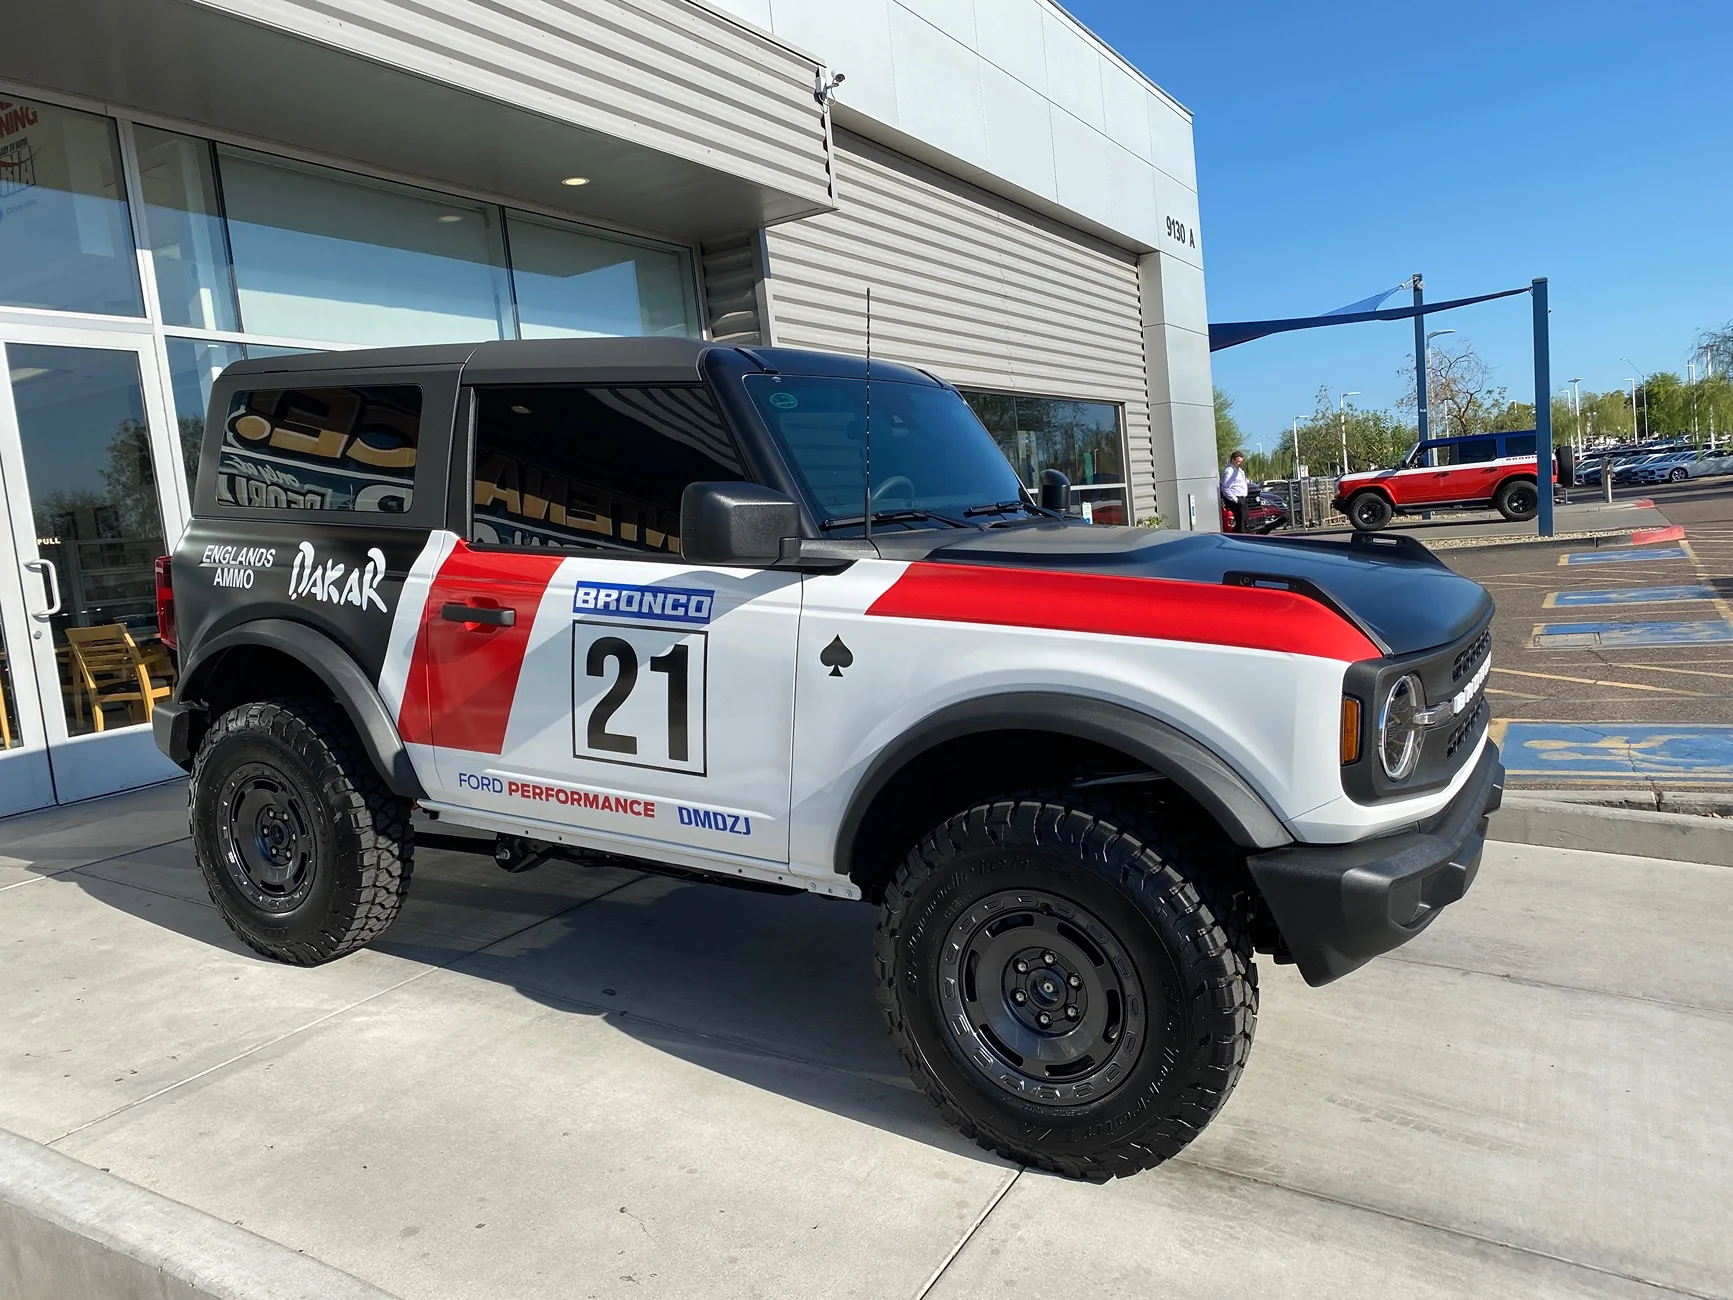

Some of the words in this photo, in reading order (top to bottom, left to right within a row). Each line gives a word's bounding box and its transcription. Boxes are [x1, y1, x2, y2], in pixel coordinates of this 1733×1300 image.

[1166, 215, 1186, 244] 9130
[1189, 228, 1195, 249] A
[37, 537, 61, 545] PULL
[202, 545, 276, 567] ENGLANDS
[213, 566, 254, 589] AMMO
[288, 541, 388, 613] DAKAR
[576, 587, 712, 618] BRONCO
[586, 636, 689, 762] 21
[458, 773, 503, 794] FORD
[507, 781, 655, 818] PERFORMANCE
[677, 806, 751, 835] DMDZJ
